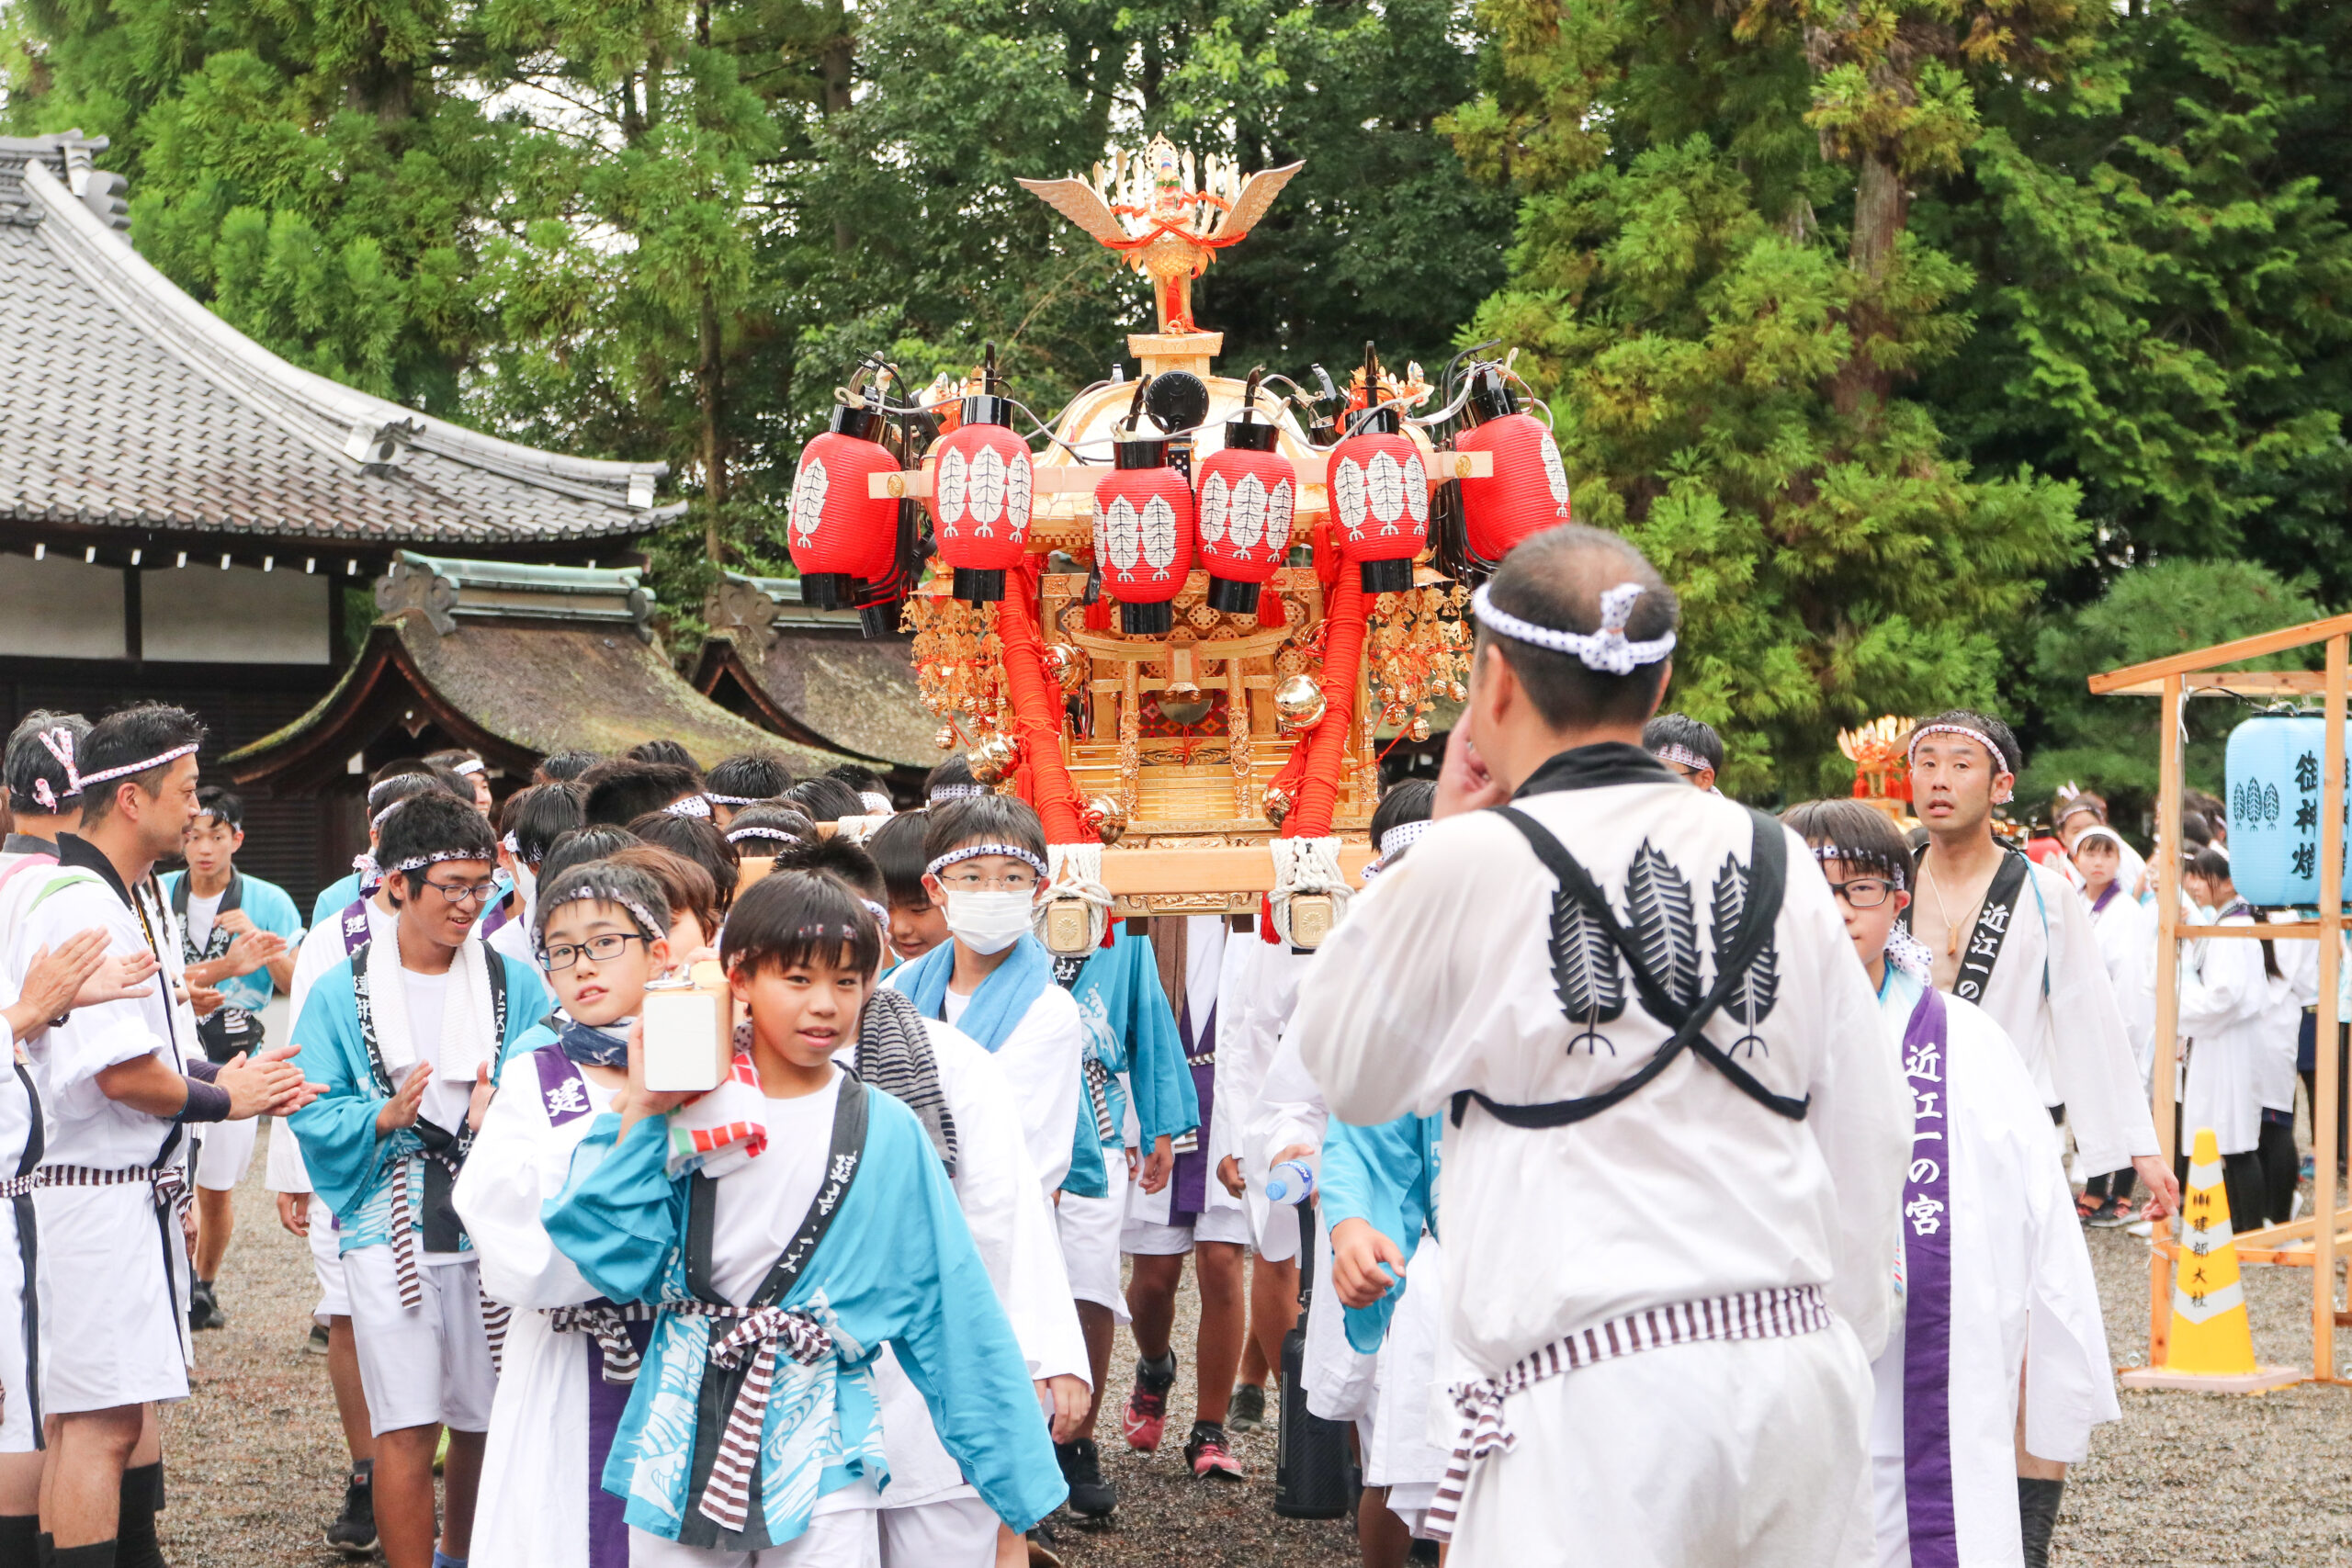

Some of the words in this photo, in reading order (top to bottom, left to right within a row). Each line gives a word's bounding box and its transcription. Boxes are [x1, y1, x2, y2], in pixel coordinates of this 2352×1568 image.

[344, 914, 370, 954] 建
[1958, 902, 2010, 999] 近江一の
[545, 1077, 589, 1117] 建
[1905, 1042, 1944, 1235] 近江一の宮
[2191, 1216, 2209, 1308] 建部大社
